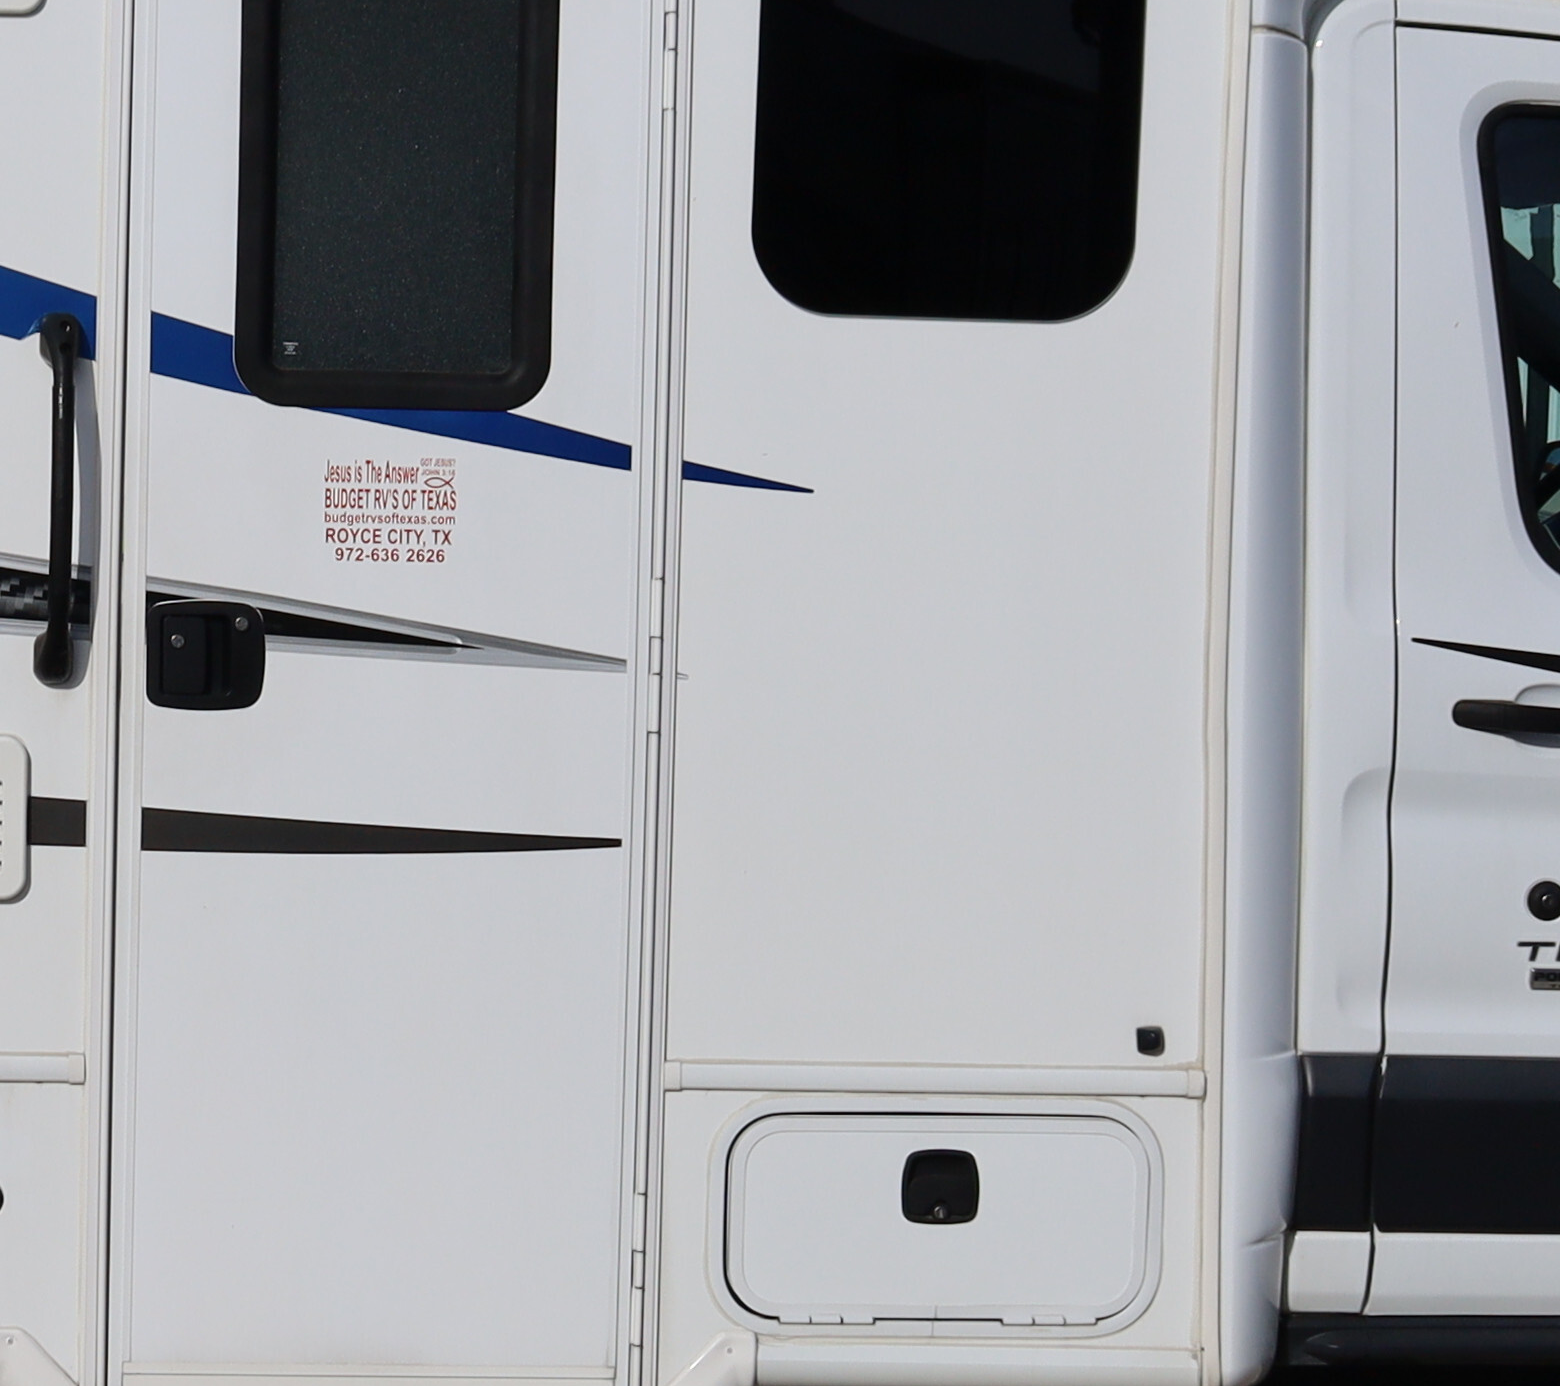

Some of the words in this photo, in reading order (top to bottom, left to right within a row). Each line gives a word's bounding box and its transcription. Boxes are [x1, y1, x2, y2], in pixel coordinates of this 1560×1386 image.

[324, 459, 351, 483] Jesus
[354, 460, 362, 483] is
[365, 460, 382, 484] The
[384, 460, 419, 484] Answer
[324, 488, 371, 509] BUDGET
[374, 489, 399, 510] RV'S
[402, 489, 417, 510] OF
[421, 490, 457, 511] TEXAS
[324, 511, 456, 526] budgetrvsoftexas.com
[325, 528, 382, 544] ROYCE
[387, 529, 426, 547] CITY,
[432, 529, 452, 545] TX
[335, 548, 400, 562] 972-636
[406, 549, 446, 563] 2626
